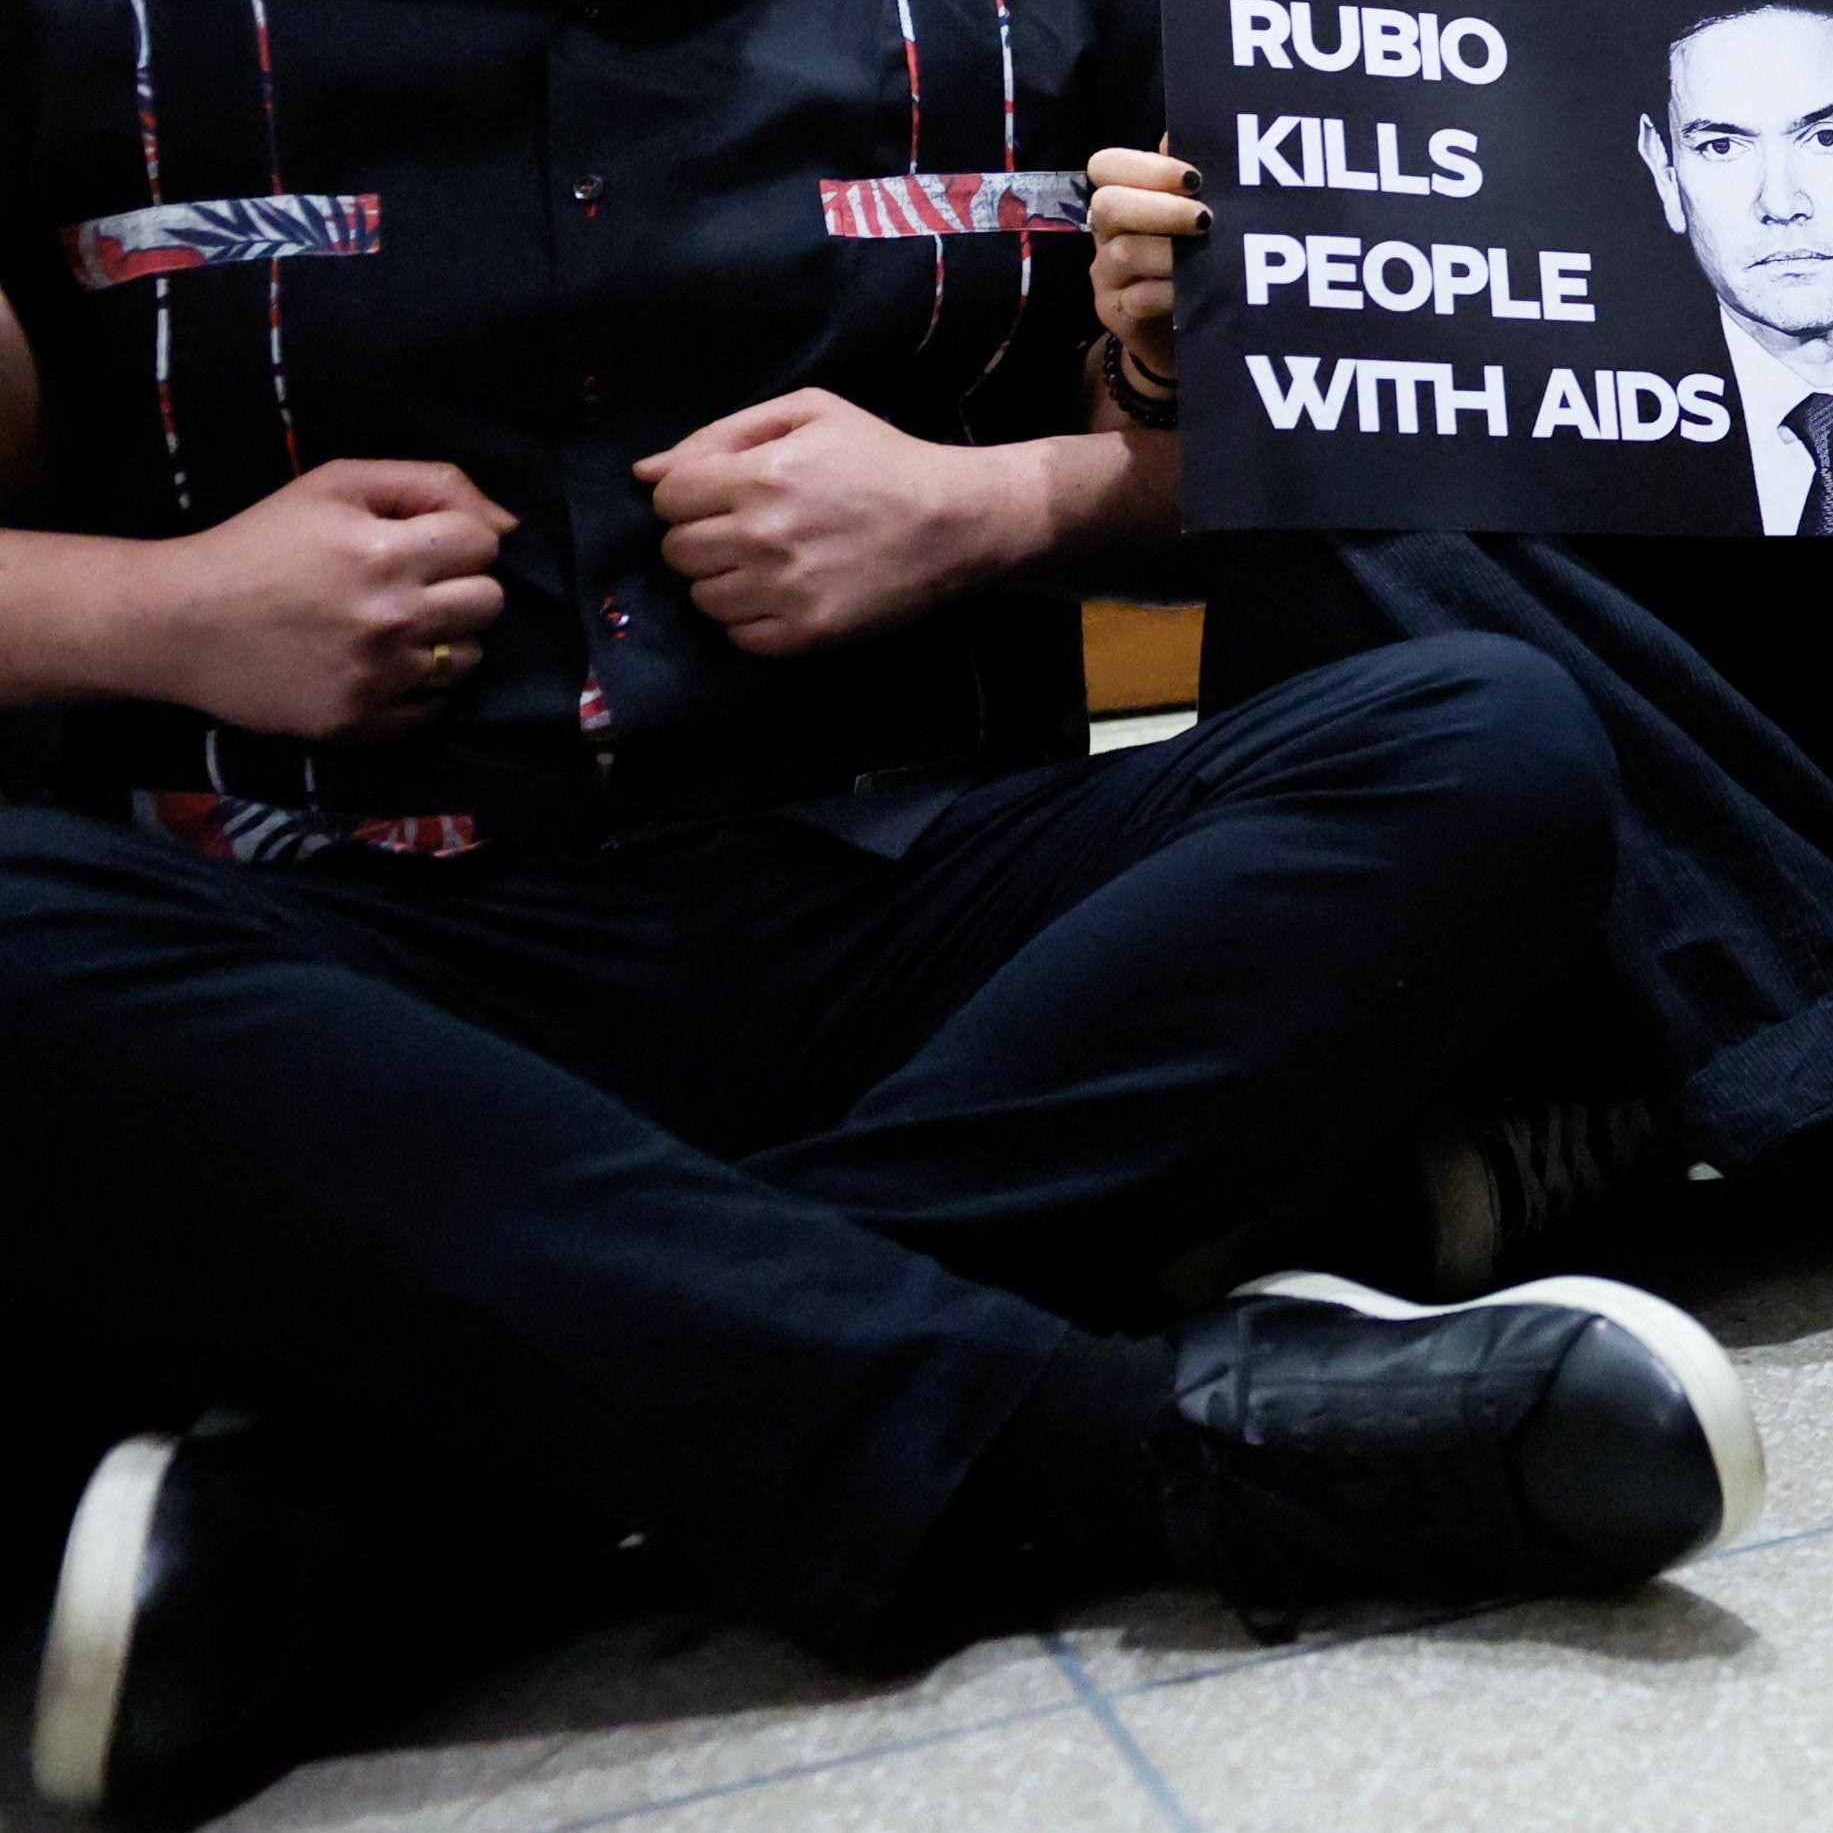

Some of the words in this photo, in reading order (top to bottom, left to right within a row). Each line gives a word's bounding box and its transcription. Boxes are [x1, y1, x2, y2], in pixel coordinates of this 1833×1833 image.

[1237, 114, 1483, 197] KILLS
[1244, 234, 1596, 322] PEOPLE
[1245, 356, 1509, 436] WITH
[1532, 369, 1731, 443] AIDS
